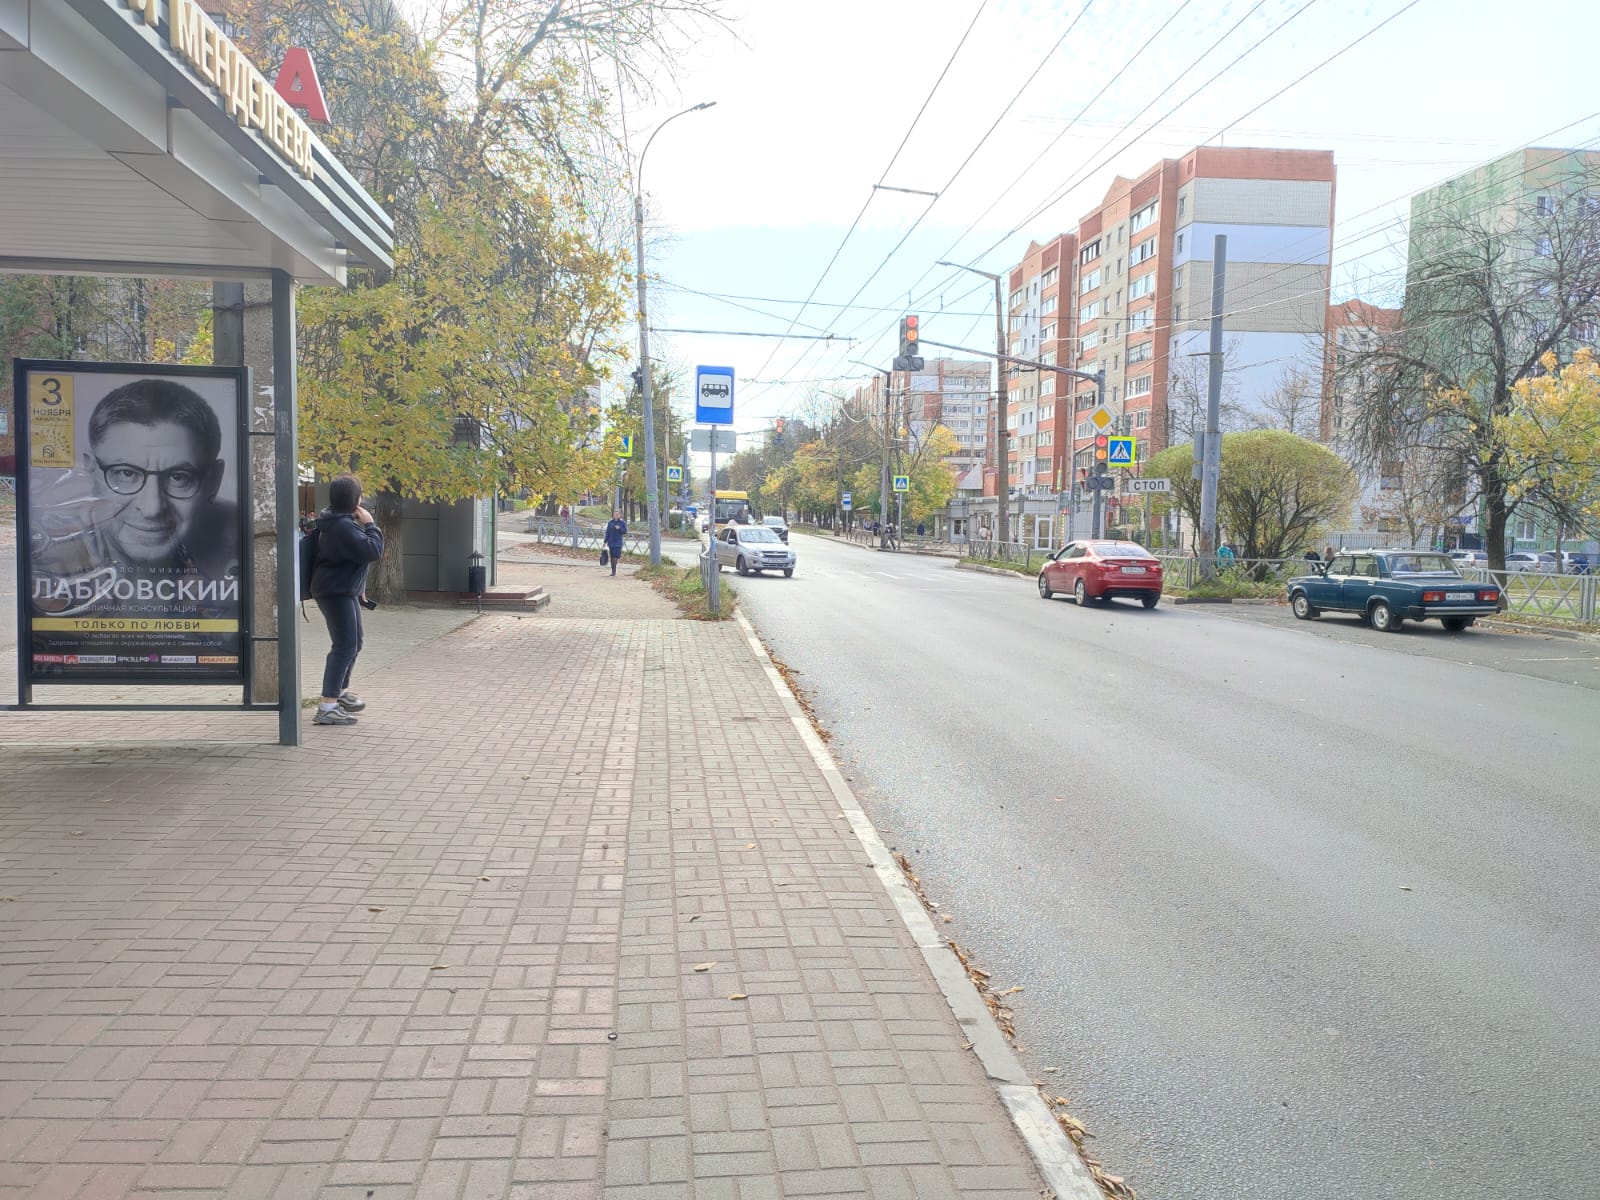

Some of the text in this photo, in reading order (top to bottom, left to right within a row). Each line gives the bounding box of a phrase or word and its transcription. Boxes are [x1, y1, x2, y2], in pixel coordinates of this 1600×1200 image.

[169, 0, 315, 180] МЕНДЕЛЕЕВА
[275, 47, 331, 125] А
[41, 377, 63, 406] 3
[32, 408, 72, 417] НОЯБРЯ
[1134, 480, 1165, 490] СТОП
[149, 567, 199, 575] МИХАИЛ
[32, 575, 239, 601] ЛАБКОВСКИЙ
[128, 604, 197, 614] КОНСУЛЬТАЦИЯ
[74, 620, 200, 630] ТОЛЬКО ПО ЛЮБВИ
